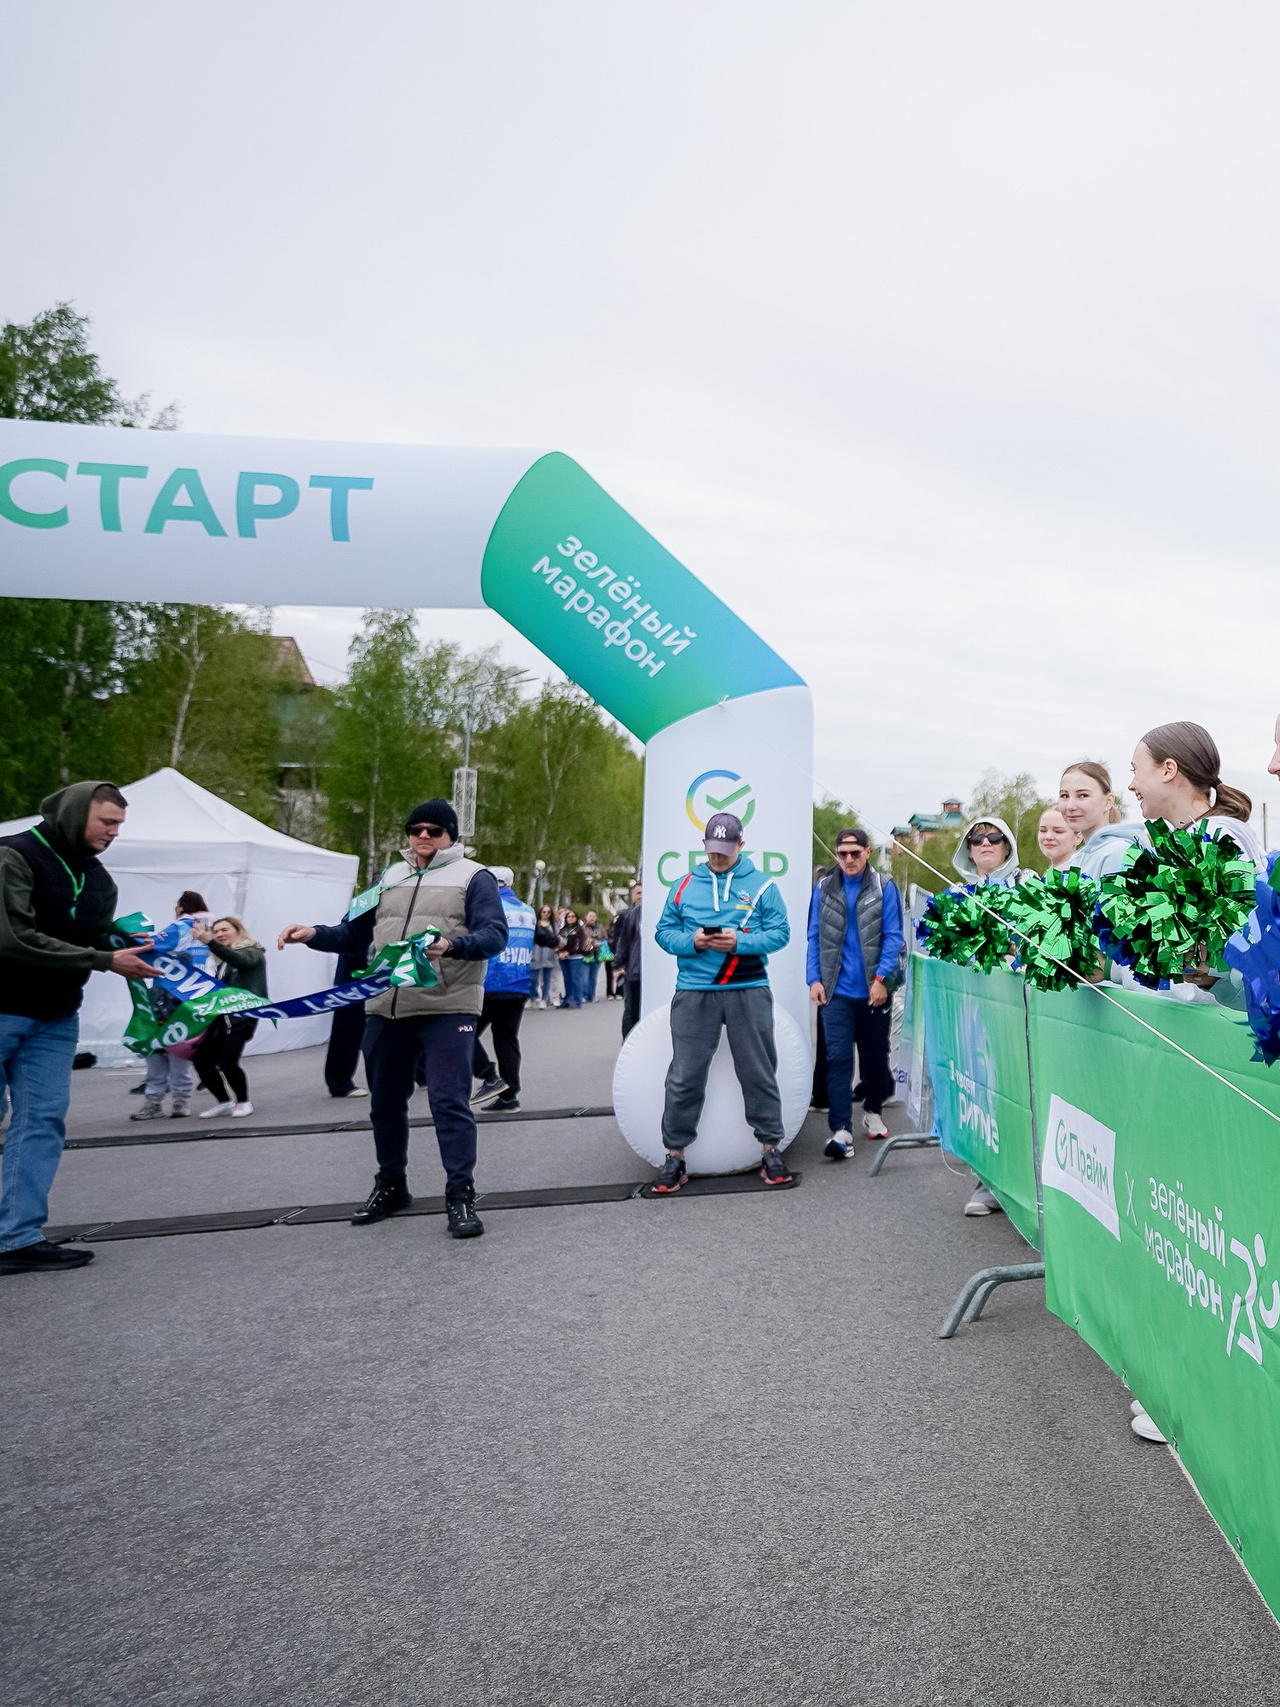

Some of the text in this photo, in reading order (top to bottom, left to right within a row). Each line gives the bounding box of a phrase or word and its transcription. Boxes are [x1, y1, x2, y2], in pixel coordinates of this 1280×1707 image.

[0, 458, 374, 542] СТАРТ
[531, 555, 667, 678] марафон
[557, 535, 697, 656] зелёный
[1069, 1132, 1110, 1195] Прайм
[1149, 1177, 1227, 1268] зелёный
[1144, 1221, 1225, 1322] марафон
